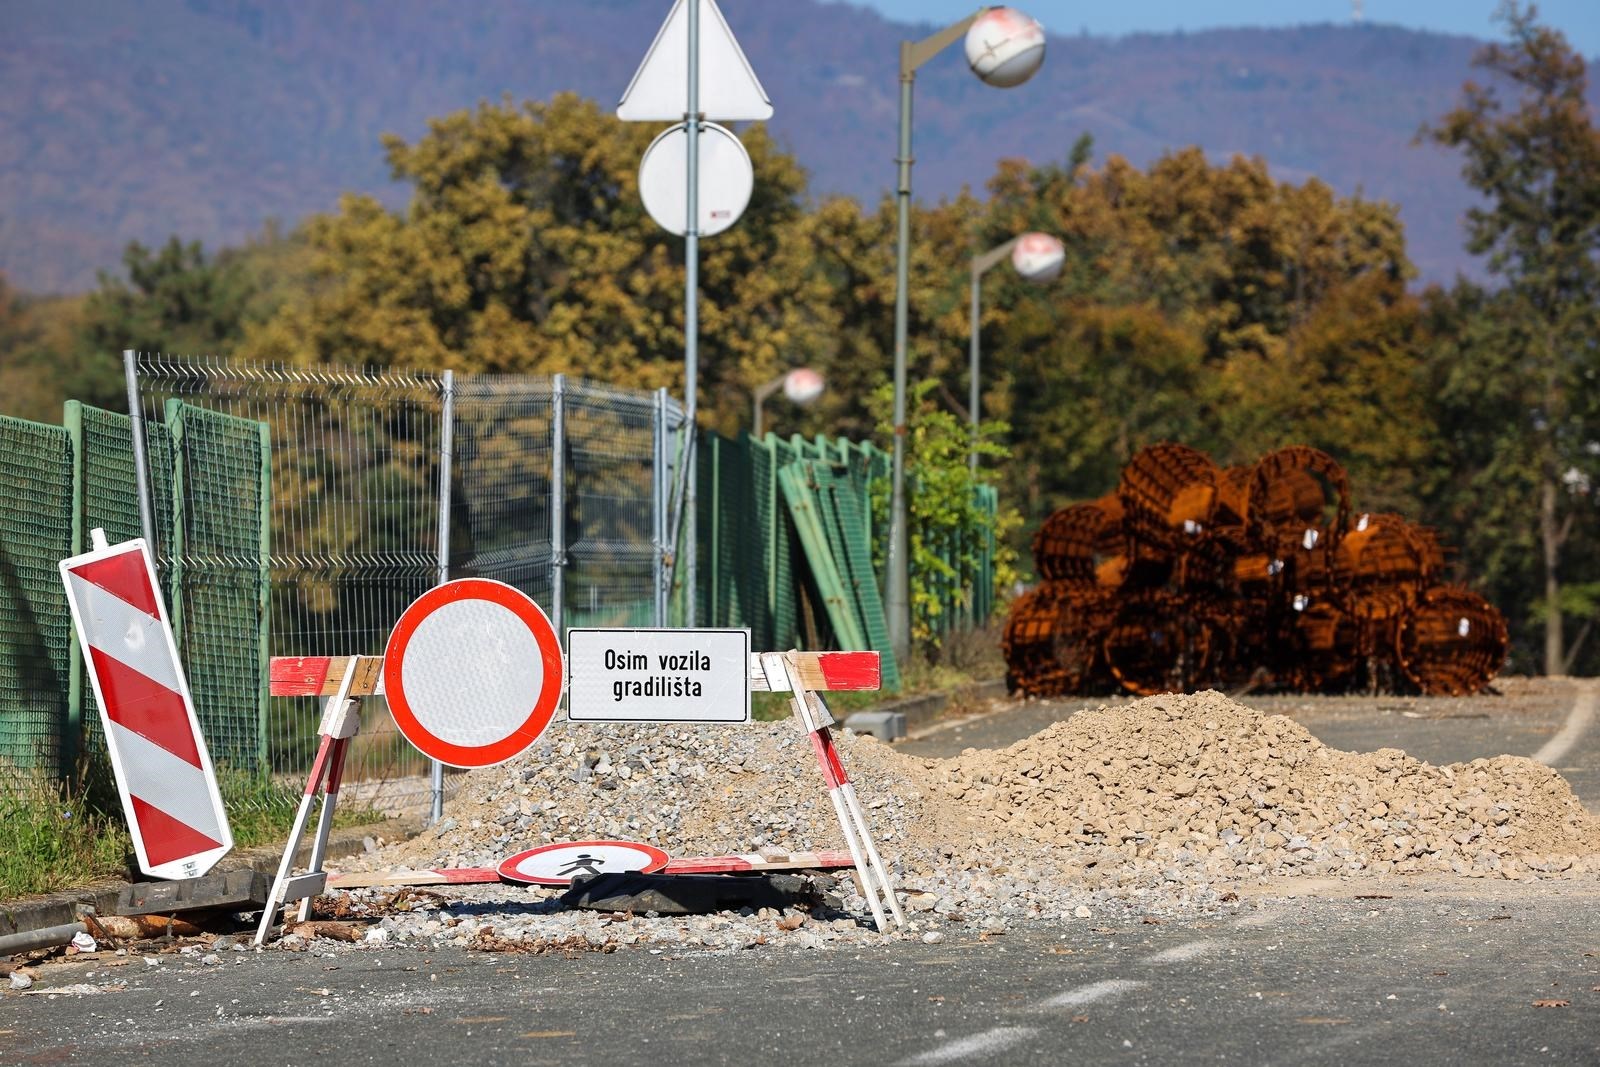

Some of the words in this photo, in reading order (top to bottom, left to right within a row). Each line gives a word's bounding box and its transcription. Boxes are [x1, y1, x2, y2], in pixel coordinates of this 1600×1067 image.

[604, 649, 648, 670] Osim
[658, 650, 711, 671] vozila
[613, 676, 702, 702] gradilišta
